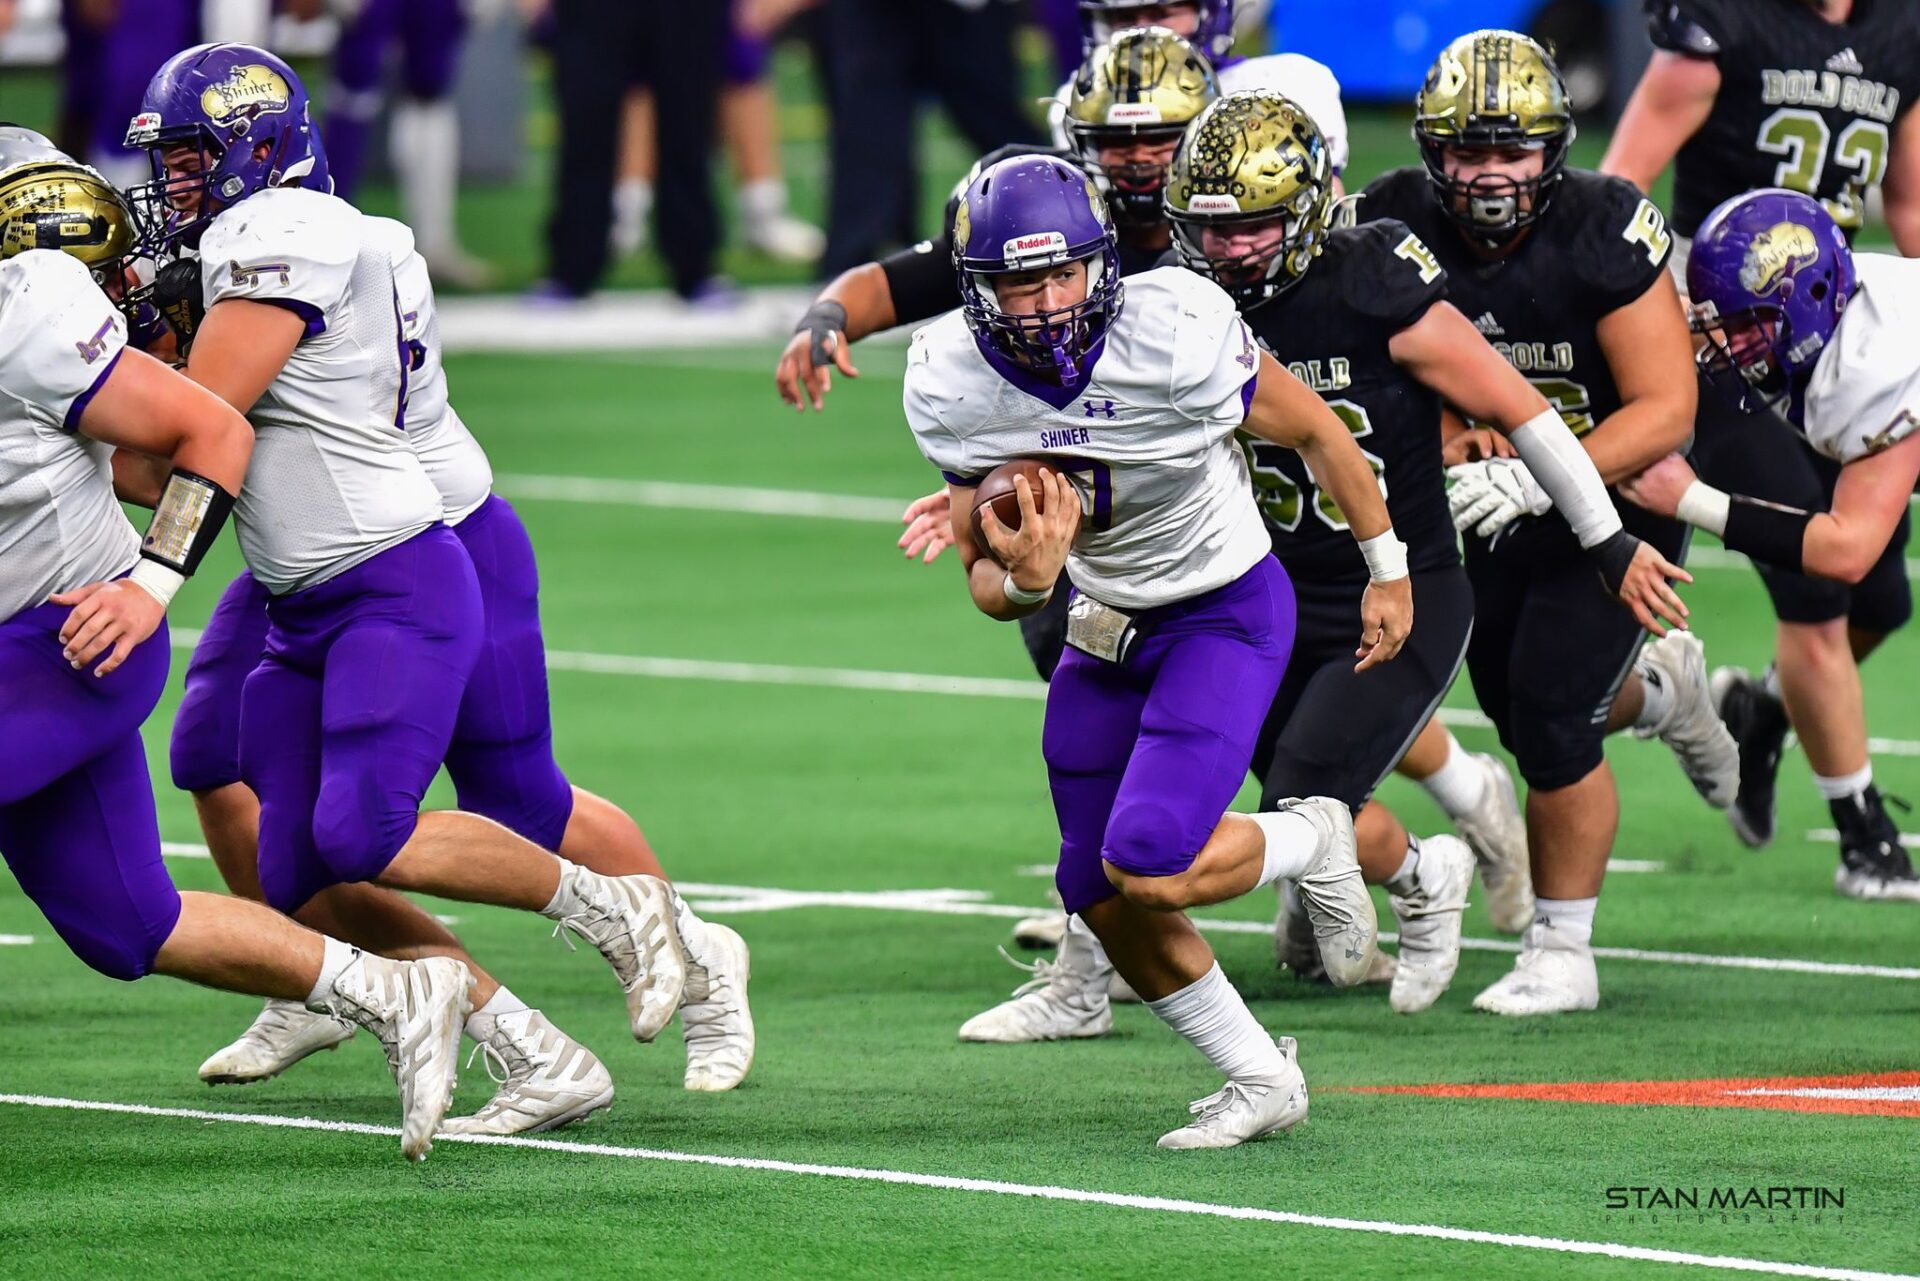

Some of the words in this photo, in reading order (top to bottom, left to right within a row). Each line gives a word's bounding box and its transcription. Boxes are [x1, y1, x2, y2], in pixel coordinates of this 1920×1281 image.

[1761, 69, 1841, 108] BOLD
[65, 225, 79, 233] WAT
[1016, 235, 1051, 250] Riddell
[1623, 198, 1670, 267] P
[1288, 356, 1351, 390] OLD
[1040, 427, 1091, 448] SHINER
